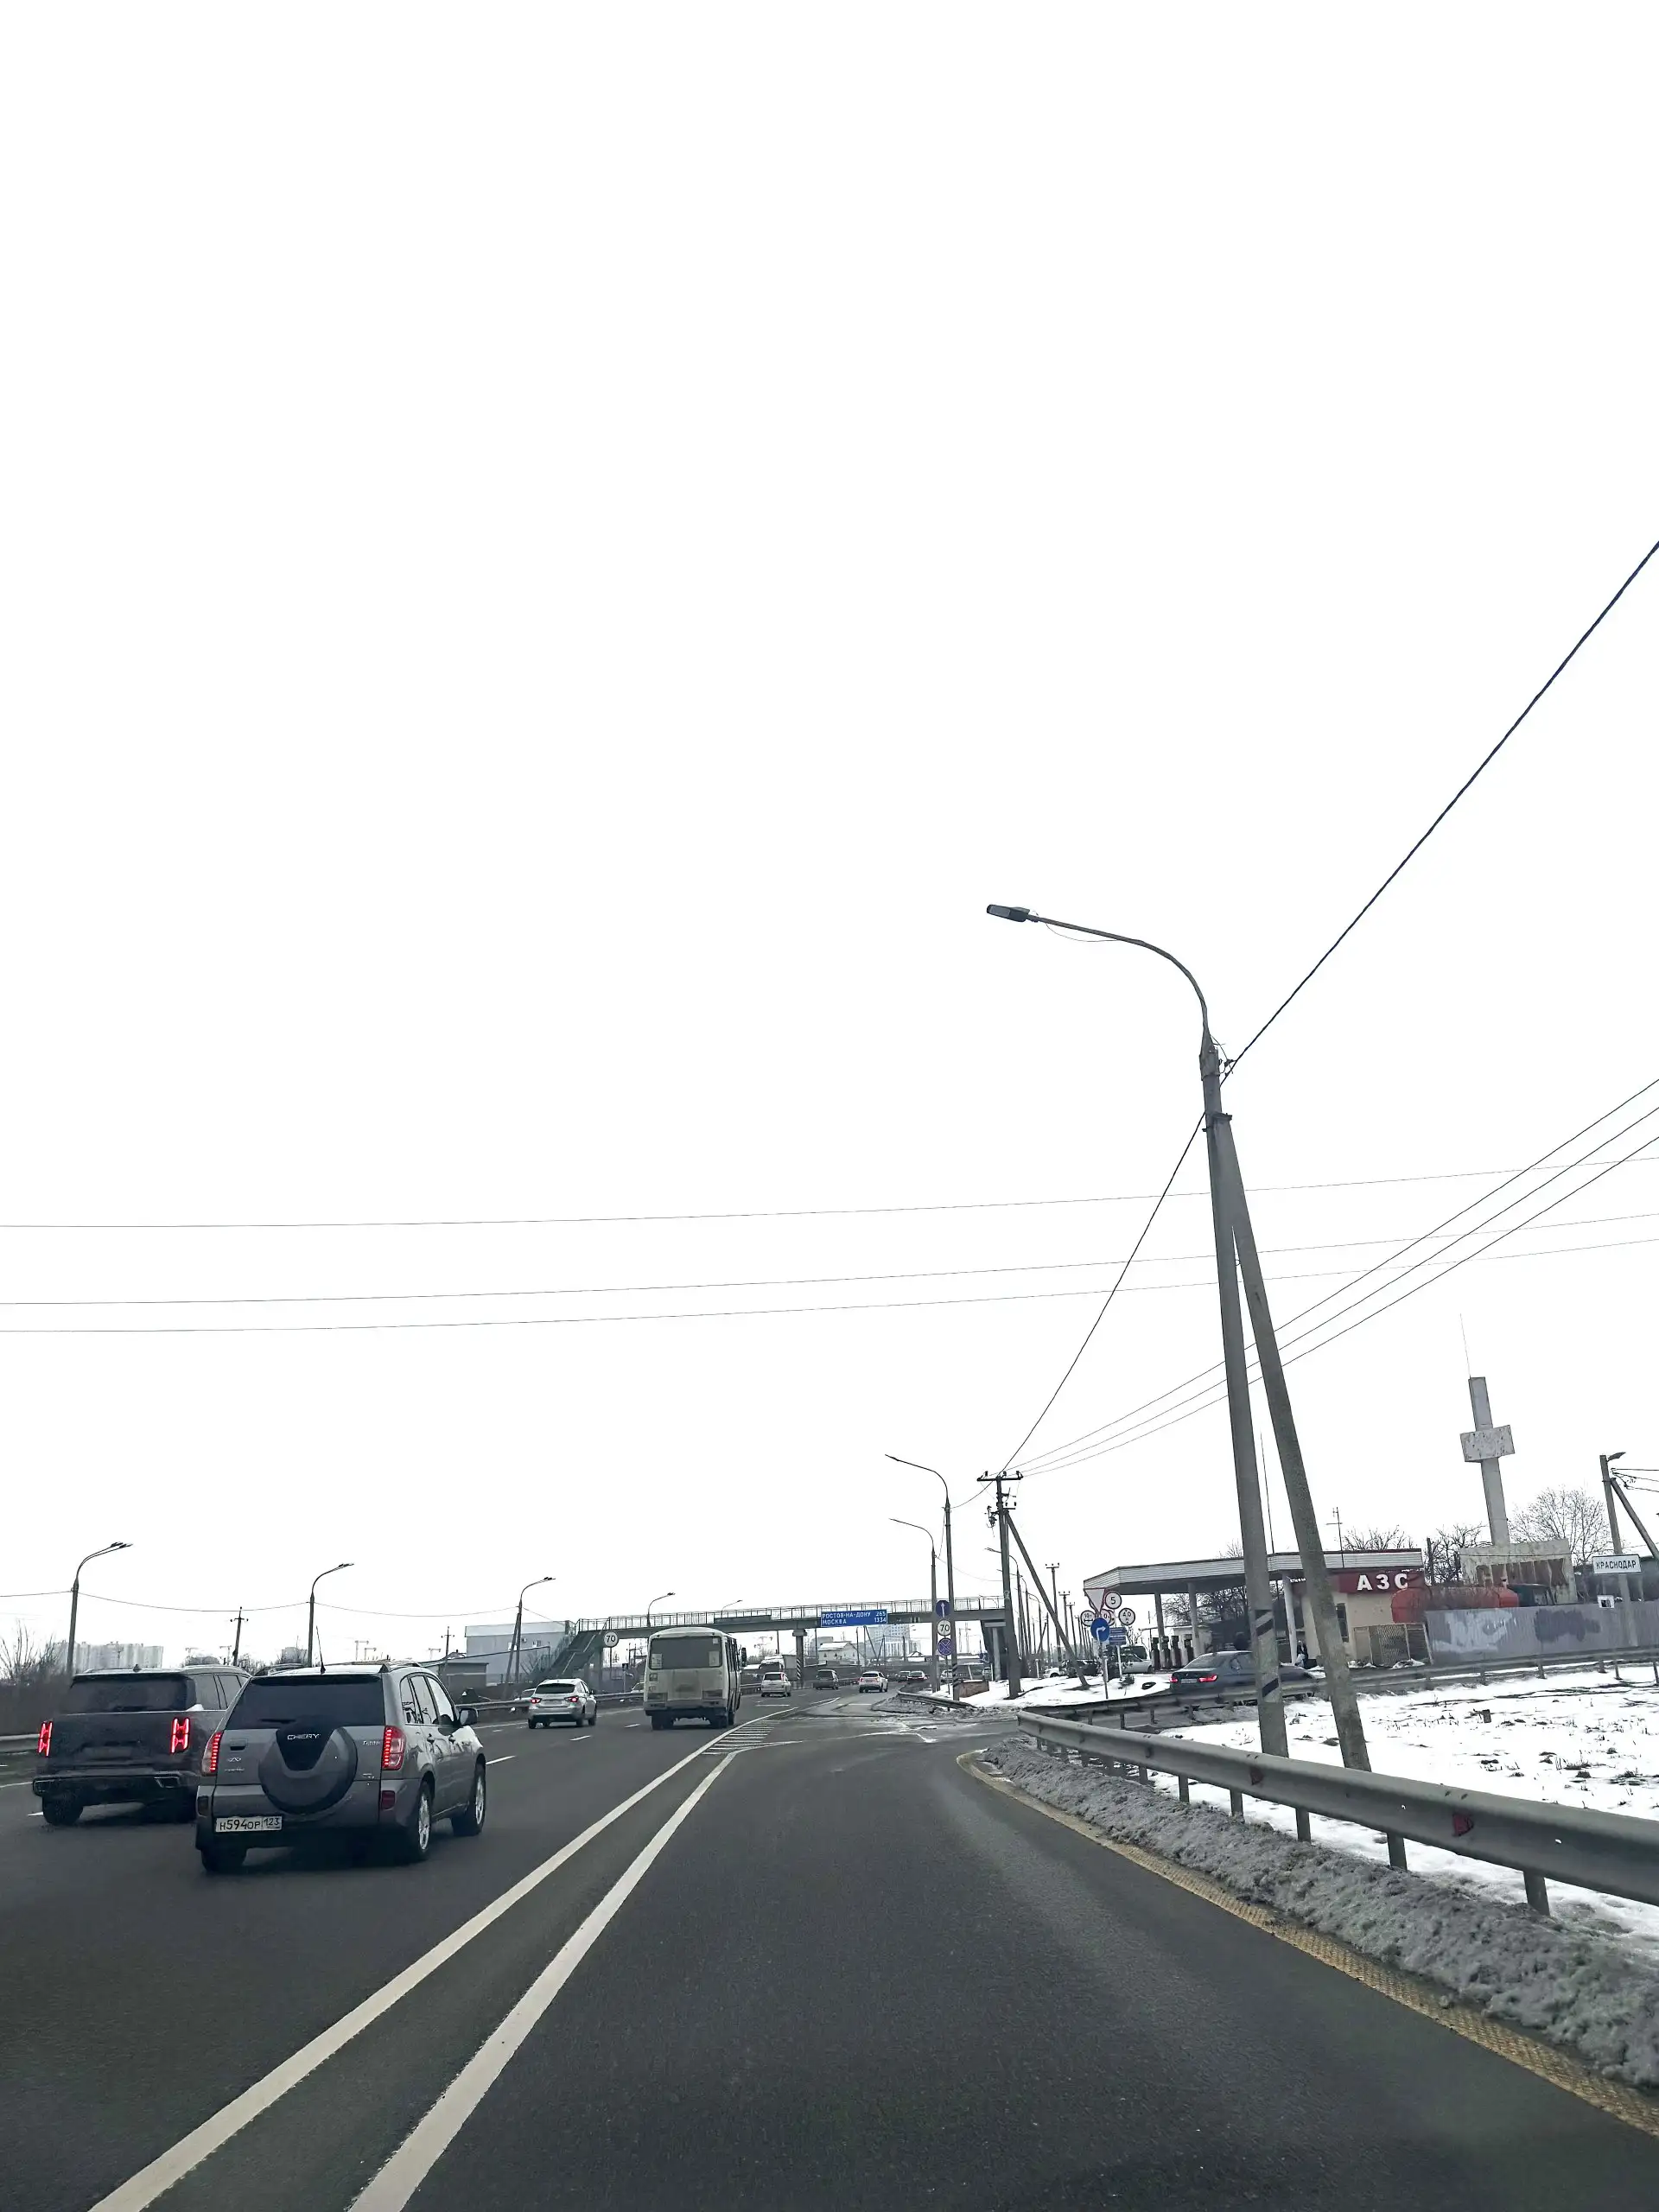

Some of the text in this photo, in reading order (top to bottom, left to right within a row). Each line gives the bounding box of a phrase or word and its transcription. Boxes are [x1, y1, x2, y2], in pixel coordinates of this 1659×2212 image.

[1596, 1560, 1637, 1570] КРАСНОДАР
[1357, 1573, 1408, 1591] АЗС
[1110, 1596, 1116, 1605] 5
[940, 1624, 950, 1632] 70
[219, 1817, 280, 1831] Н594ОР 123
